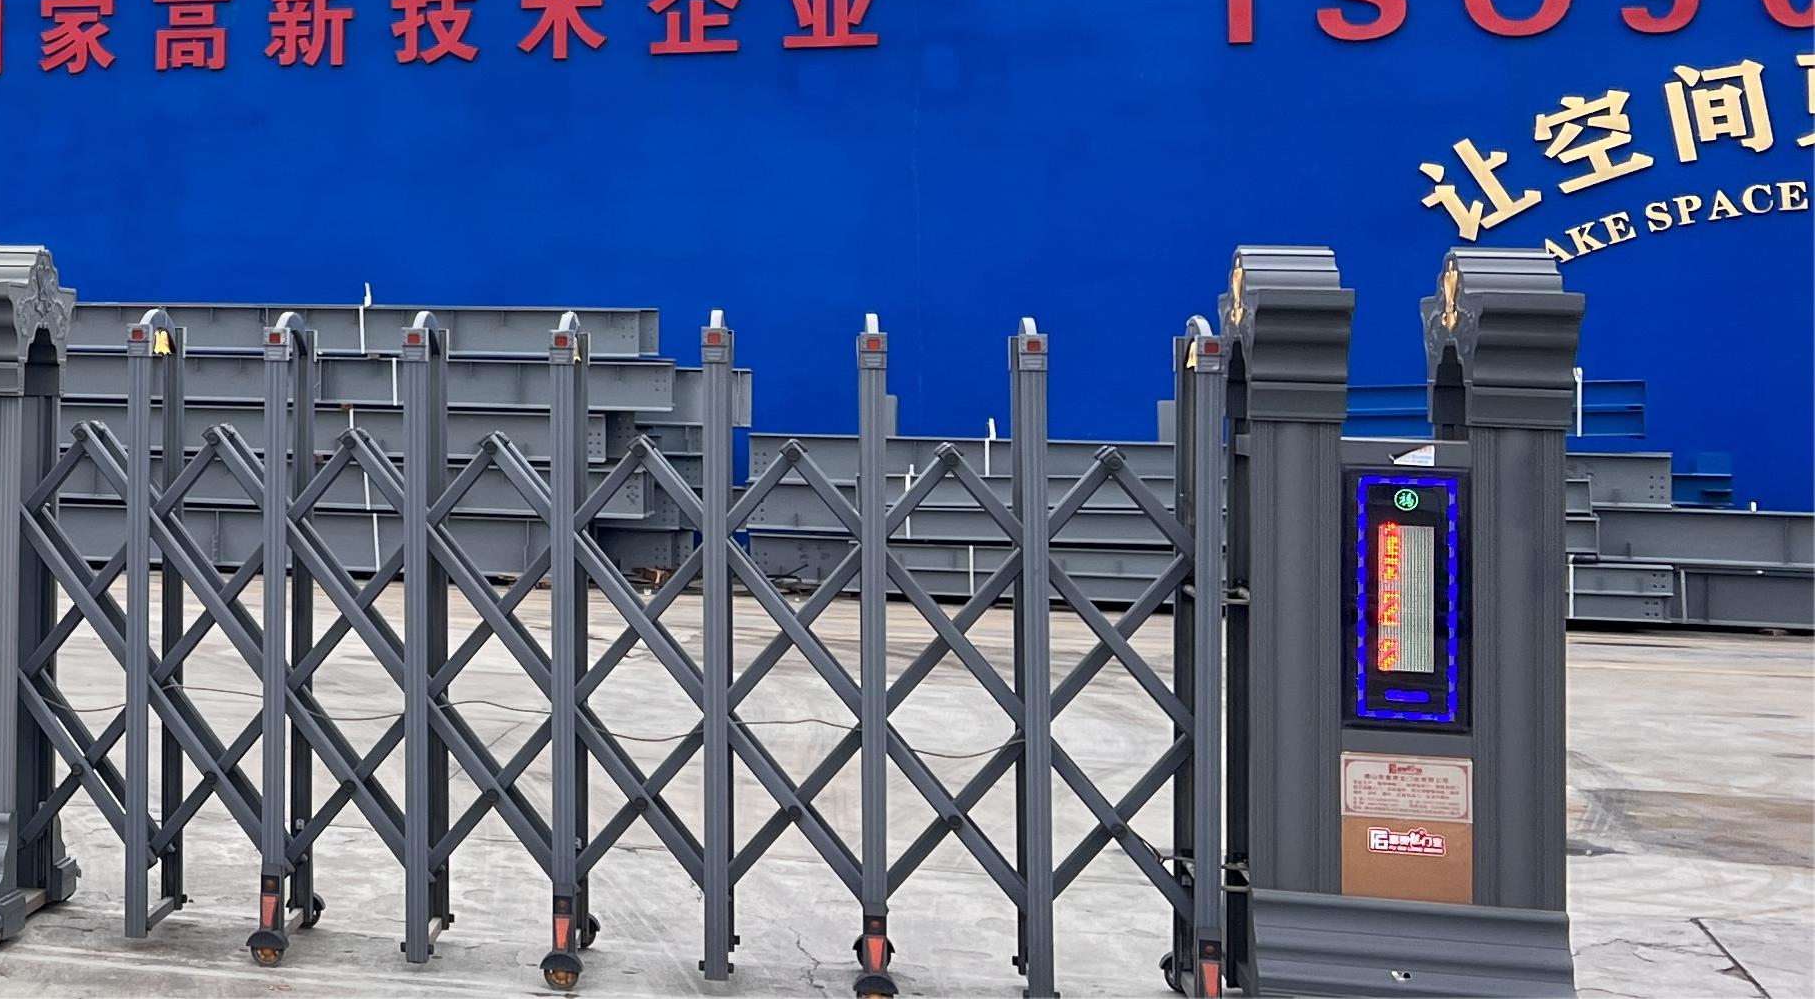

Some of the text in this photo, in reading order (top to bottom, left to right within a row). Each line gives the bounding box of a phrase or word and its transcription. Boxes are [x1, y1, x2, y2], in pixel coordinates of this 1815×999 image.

[1419, 54, 1815, 242] 让空间
[1544, 180, 1810, 264] AKE SPACE
